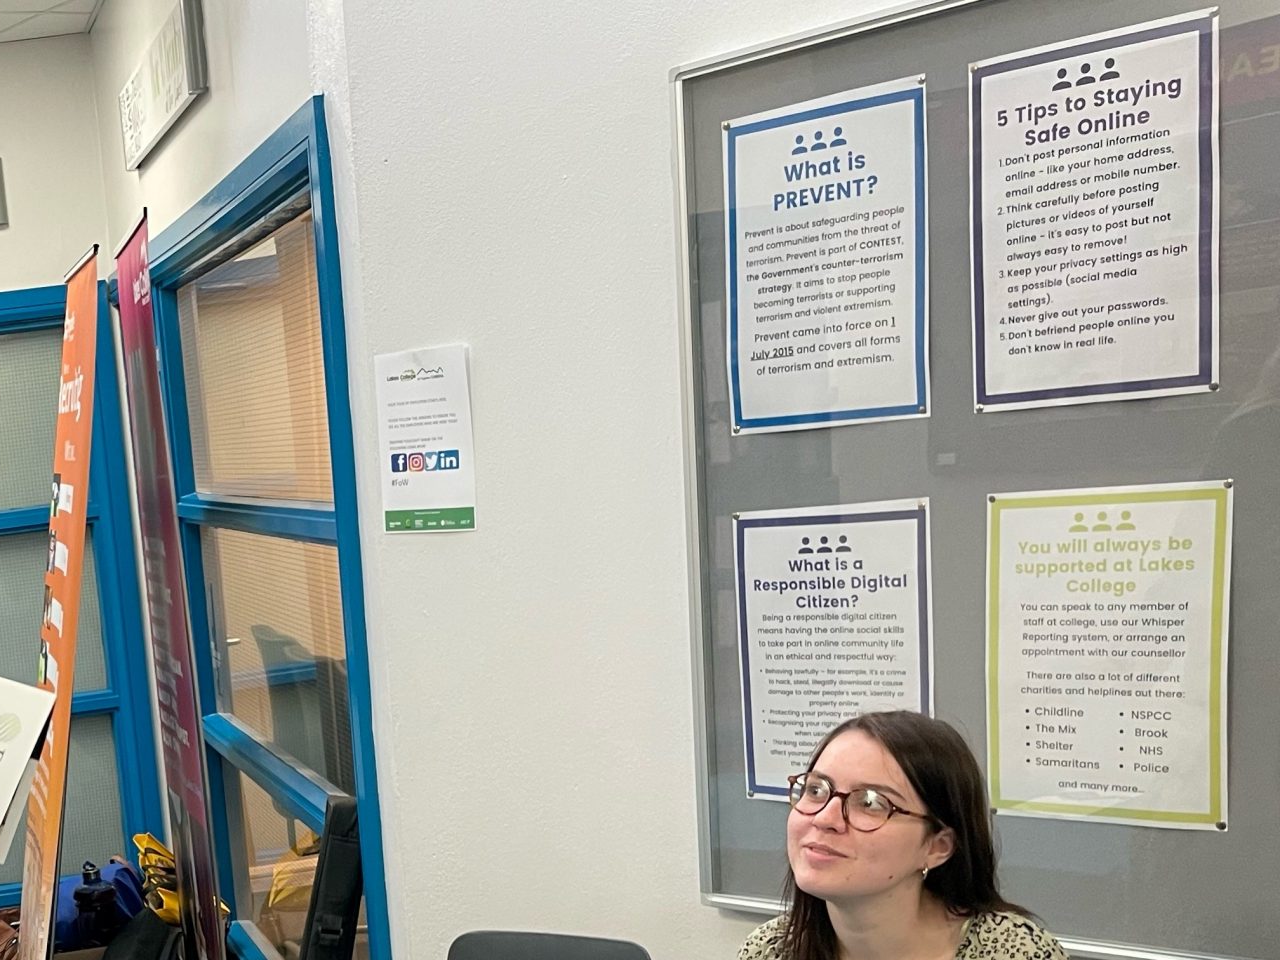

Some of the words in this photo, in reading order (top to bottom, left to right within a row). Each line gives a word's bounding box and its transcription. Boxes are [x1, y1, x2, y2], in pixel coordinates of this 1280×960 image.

[997, 109, 1008, 127] 5
[1014, 102, 1058, 126] Tips
[1064, 96, 1086, 113] to
[1093, 77, 1181, 107] Staying
[1024, 122, 1071, 146] Safe
[1077, 110, 1150, 135] Online
[783, 155, 841, 182] What
[847, 150, 866, 171] is
[773, 174, 878, 211] PREVENT?
[1005, 184, 1033, 198] email
[1035, 178, 1077, 193] address
[1079, 176, 1091, 185] or
[1093, 168, 1130, 183] mobile
[1034, 194, 1080, 209] carefully
[1082, 188, 1116, 201] before
[1118, 181, 1159, 198] posting
[744, 226, 774, 239] Prevent
[775, 225, 783, 234] is
[784, 220, 810, 232] about
[811, 211, 870, 228] safeguarding
[871, 205, 905, 221] people
[1006, 216, 1046, 232] pictures
[1048, 214, 1059, 223] or
[1061, 208, 1096, 220] videos
[1098, 204, 1109, 215] of
[1111, 196, 1154, 216] yourself
[785, 248, 817, 261] Prevent
[818, 247, 826, 256] is
[827, 244, 846, 257] part
[848, 241, 857, 251] of
[1006, 249, 1042, 262] always
[1043, 245, 1068, 256] easy
[1070, 243, 1081, 252] to
[1083, 234, 1127, 250] remove!
[746, 273, 760, 282] the
[820, 252, 904, 270] counter-terrorism
[1007, 284, 1019, 293] as
[1021, 278, 1063, 294] possible
[1065, 271, 1100, 287] (social
[1102, 267, 1137, 280] media
[754, 329, 790, 343] Prevent
[791, 327, 821, 338] came
[822, 324, 843, 334] into
[844, 320, 872, 331] force
[874, 318, 888, 328] on
[750, 349, 770, 361] July
[772, 345, 794, 359] 2015
[796, 343, 816, 354] and
[818, 340, 852, 352] covers
[854, 337, 867, 348] all
[869, 335, 901, 346] forms
[1008, 344, 1032, 355] don't
[1034, 343, 1061, 352] know
[1063, 340, 1073, 349] in
[1075, 336, 1095, 348] real
[756, 365, 766, 376] of
[767, 362, 812, 374] terrorism
[813, 358, 834, 369] and
[1017, 540, 1051, 554] You
[1056, 538, 1088, 553] will
[1092, 537, 1161, 556] always
[1167, 535, 1193, 550] be
[788, 558, 830, 572] What
[834, 556, 848, 571] is
[852, 559, 863, 570] a
[1014, 558, 1107, 578] supported
[1112, 558, 1133, 572] at
[1138, 556, 1195, 572] Lakes
[753, 576, 846, 595] Responsible
[850, 573, 907, 592] Digital
[1065, 577, 1137, 597] College
[795, 594, 859, 608] Citizen?
[1022, 632, 1069, 643] Reporting
[1125, 634, 1168, 645] arrange
[1170, 634, 1185, 642] an
[1021, 647, 1085, 658] appointment
[1087, 648, 1108, 656] with
[1110, 649, 1128, 657] our
[1130, 648, 1186, 658] counsellor
[1020, 685, 1062, 694] charities
[1064, 686, 1085, 695] and
[1087, 686, 1132, 698] helplines
[1134, 688, 1152, 697] out
[1034, 706, 1084, 717] Childline
[1130, 710, 1172, 721] NSPCC
[1035, 723, 1055, 733] The
[1057, 724, 1076, 734] Mix
[1134, 727, 1168, 738] Brook
[1035, 739, 1073, 751] Shelter
[1139, 745, 1163, 756] NHS
[1035, 756, 1100, 769] Samaritans
[1133, 762, 1169, 773] Police
[1057, 780, 1078, 788] and
[1079, 782, 1109, 792] many
